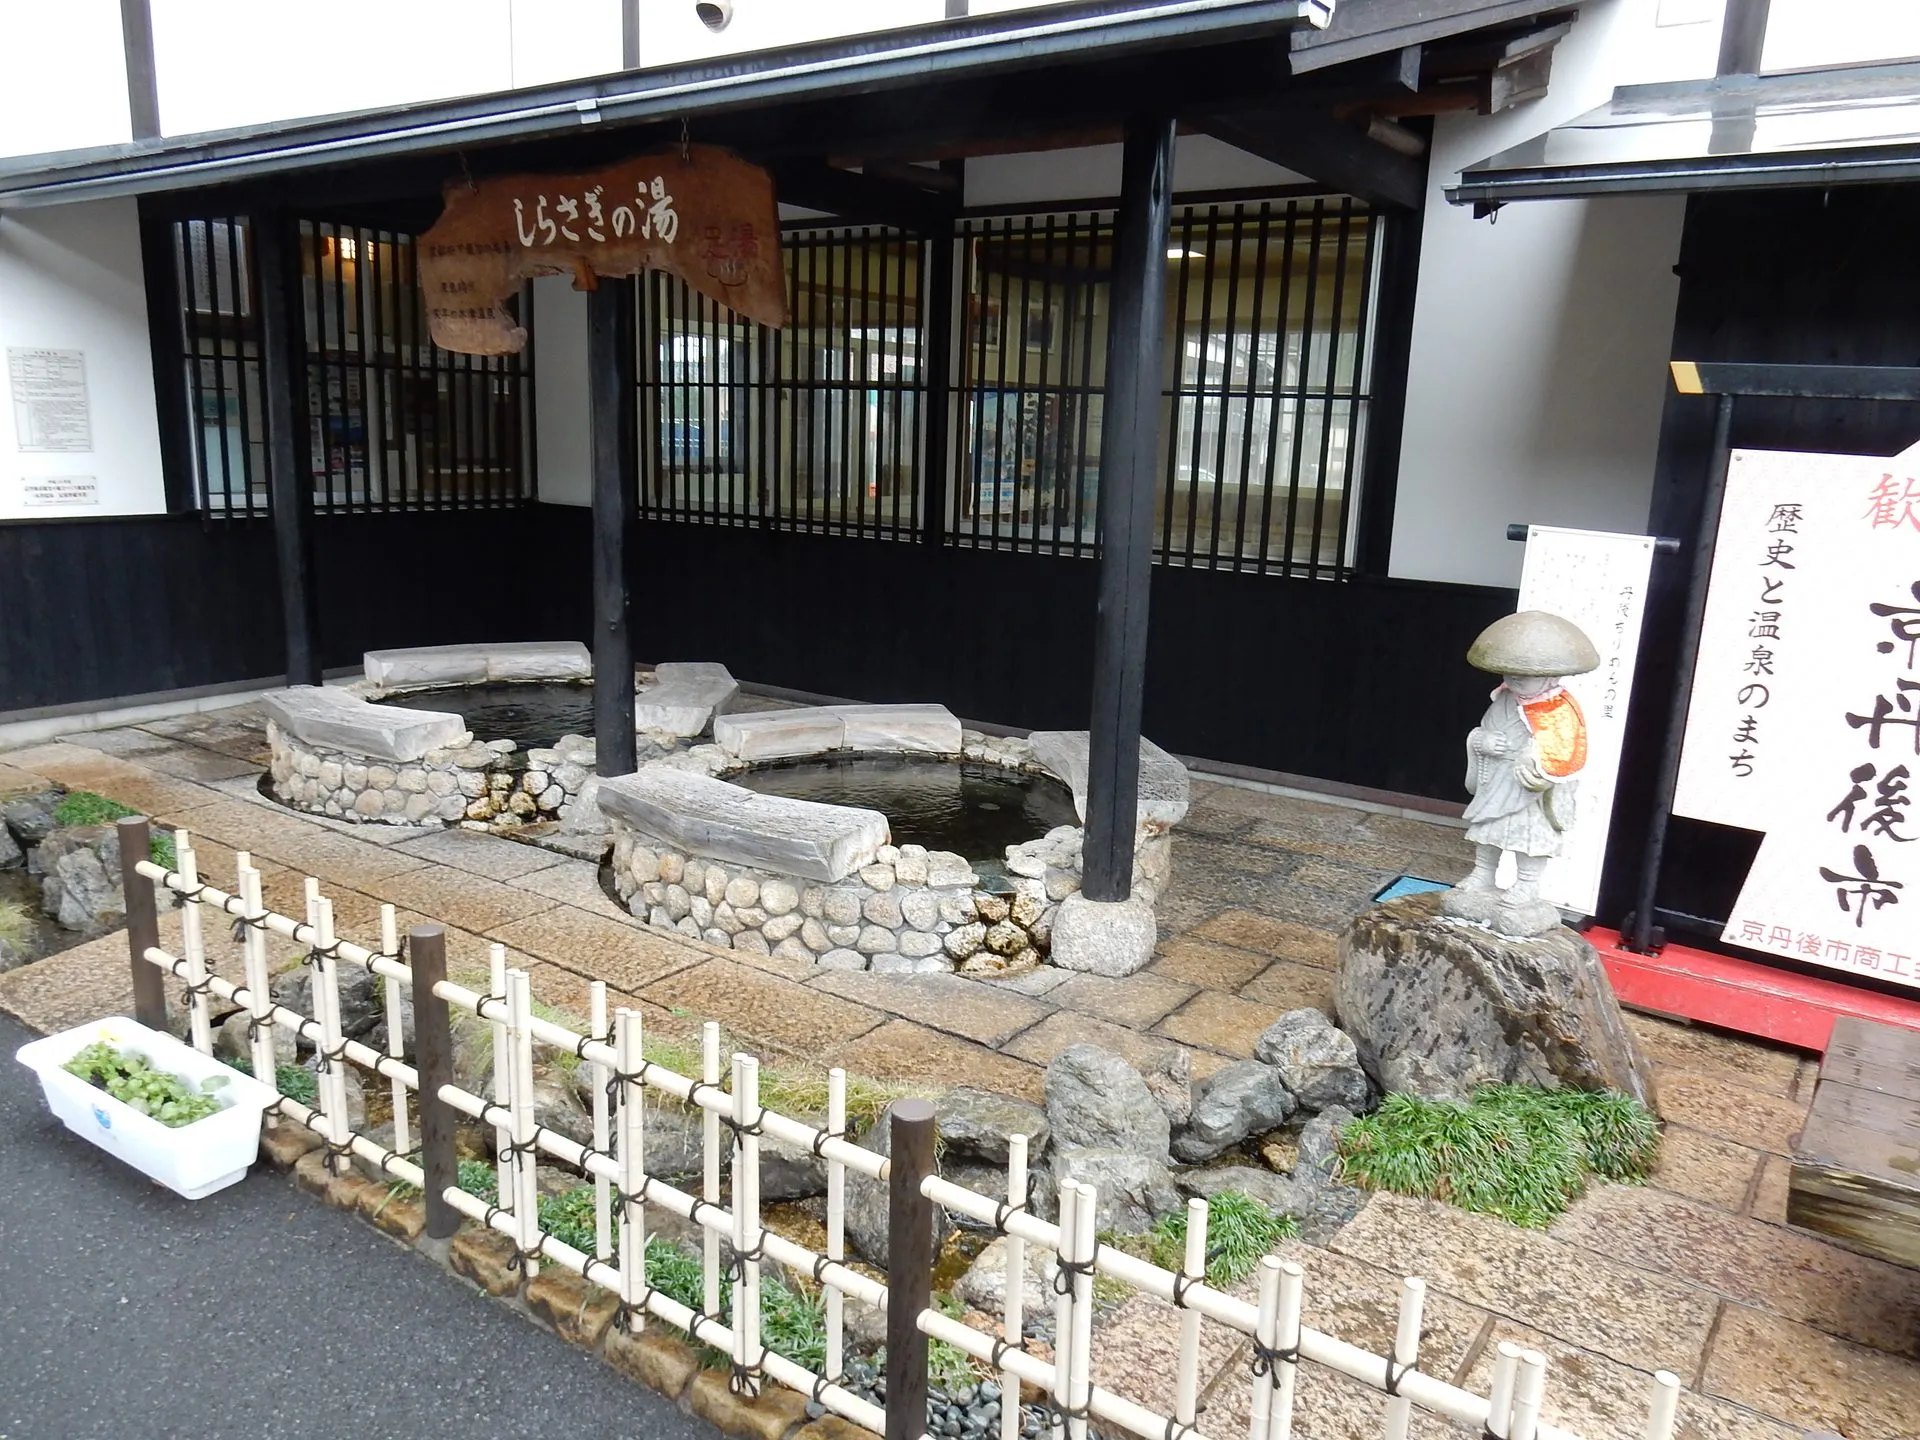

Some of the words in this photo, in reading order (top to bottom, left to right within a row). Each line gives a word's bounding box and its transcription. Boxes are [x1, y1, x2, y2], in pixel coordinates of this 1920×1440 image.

[513, 176, 679, 248] しらさぎの湯
[1728, 503, 1804, 777] 歴史と温泉のまち
[1740, 919, 1920, 980] 京丹後市商工
